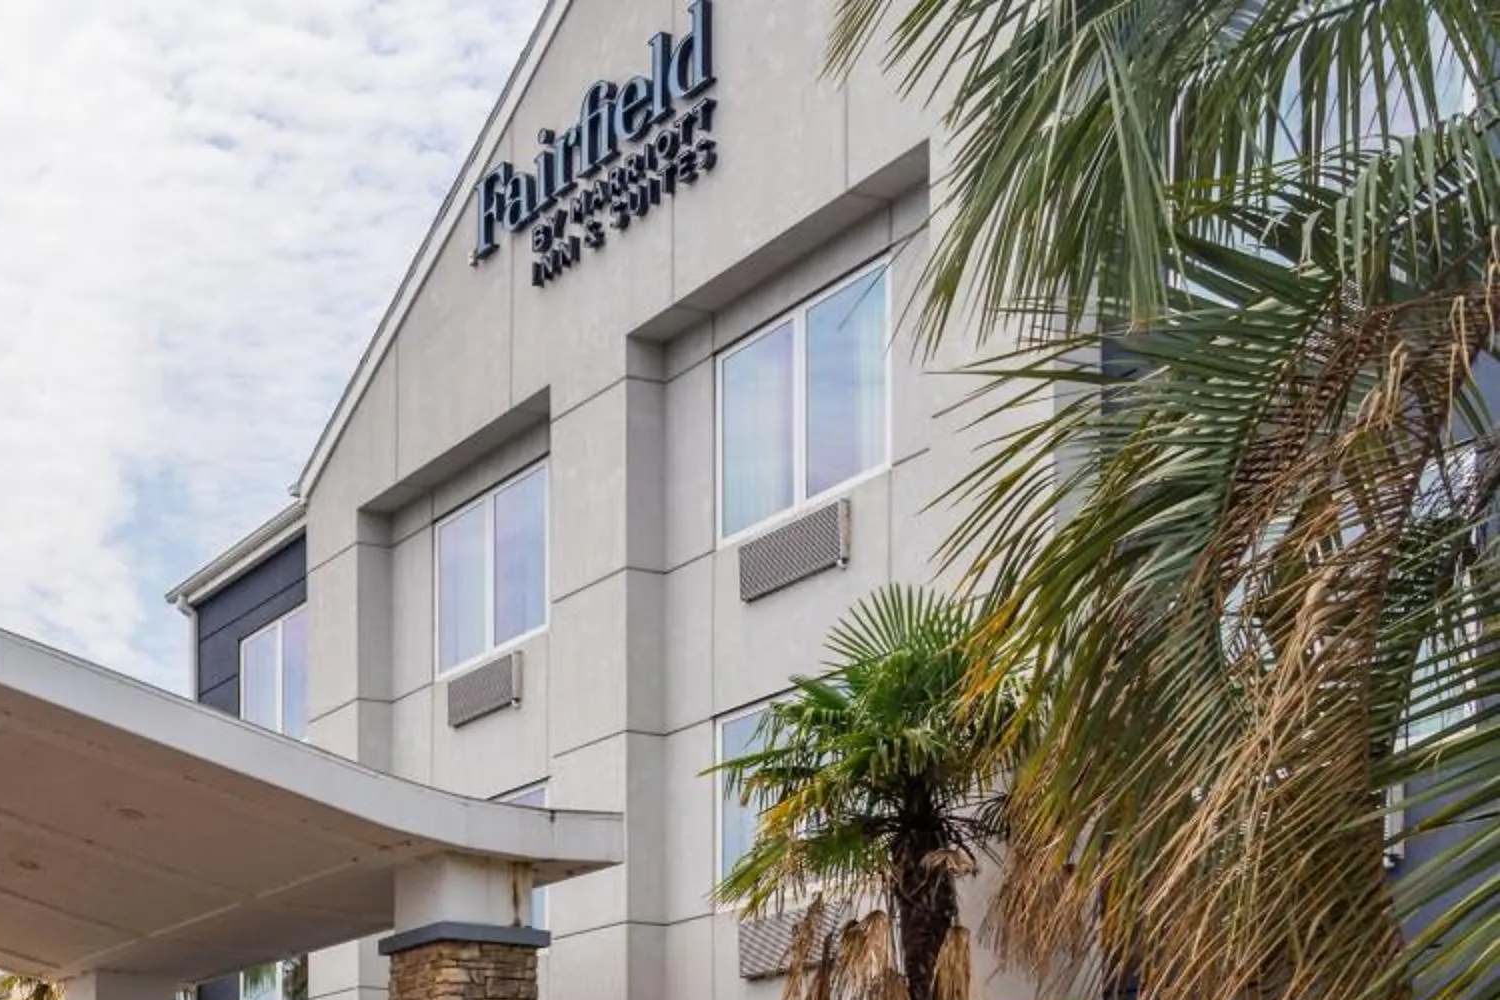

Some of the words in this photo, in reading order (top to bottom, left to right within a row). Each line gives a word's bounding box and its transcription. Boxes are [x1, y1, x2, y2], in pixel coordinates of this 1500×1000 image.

[474, 0, 717, 258] Fairfield
[531, 208, 568, 253] BY
[569, 97, 717, 225] MARRIOTT
[531, 235, 581, 288] INN
[609, 139, 717, 230] SUITES
